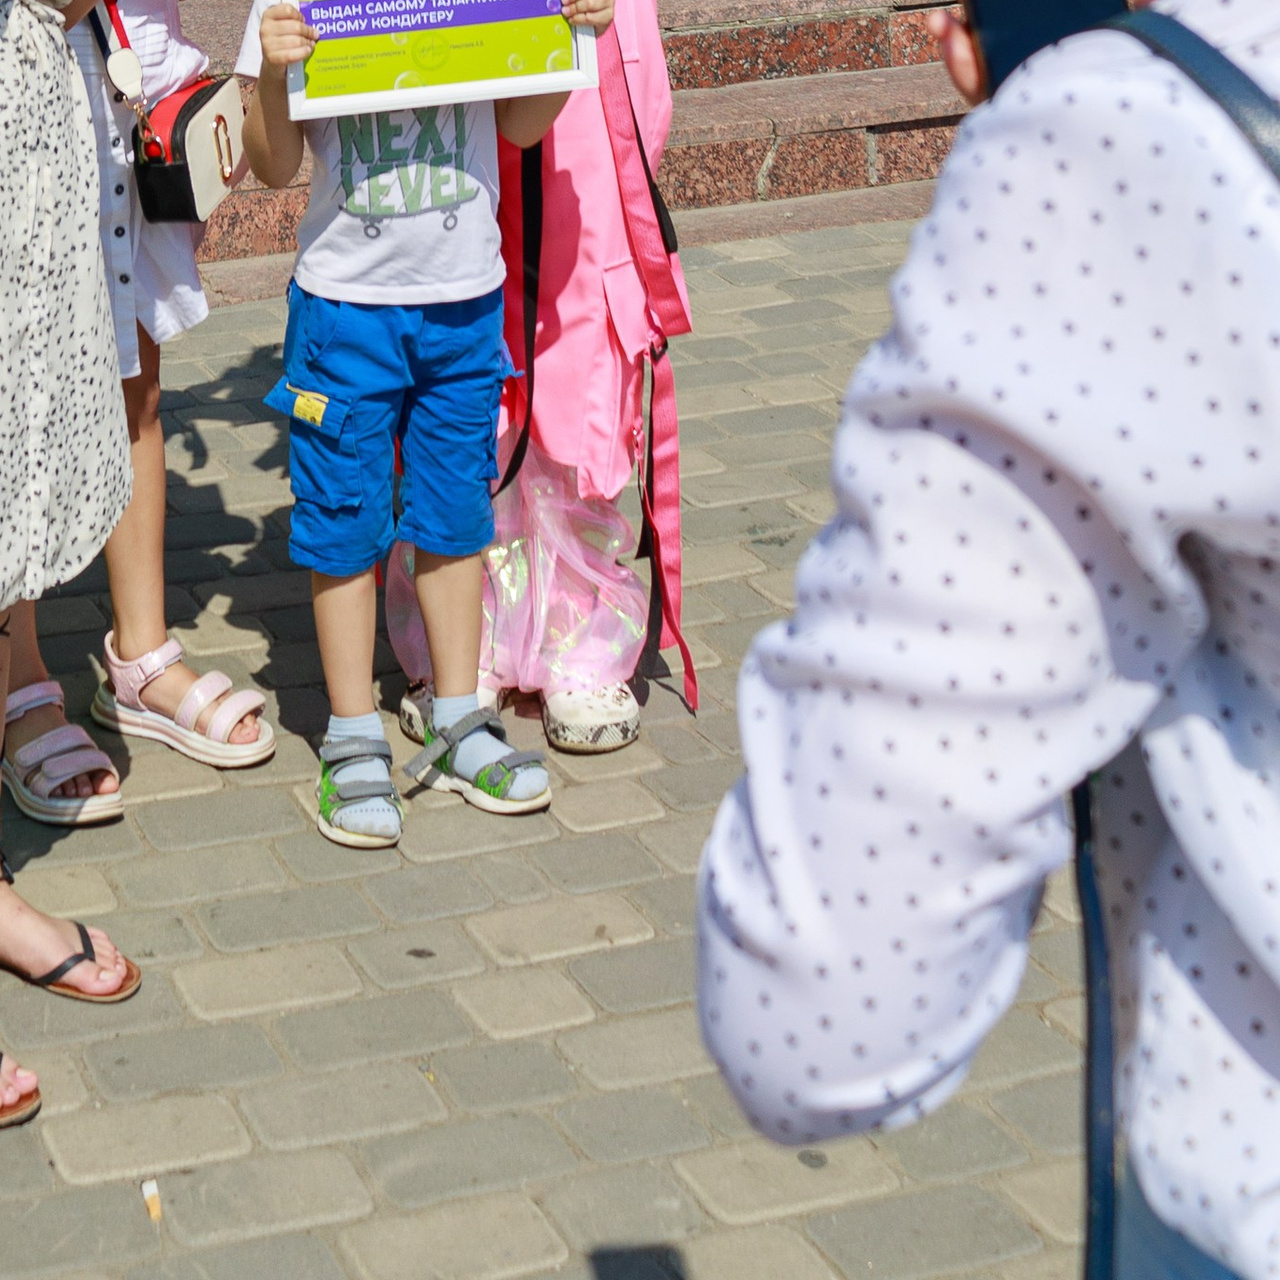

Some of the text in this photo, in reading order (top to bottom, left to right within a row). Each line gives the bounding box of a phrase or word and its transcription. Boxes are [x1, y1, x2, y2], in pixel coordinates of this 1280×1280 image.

[311, 4, 362, 20] ВЫДАН
[371, 9, 454, 30] КОНДИТЕРУ
[341, 149, 475, 216] LEVEL
